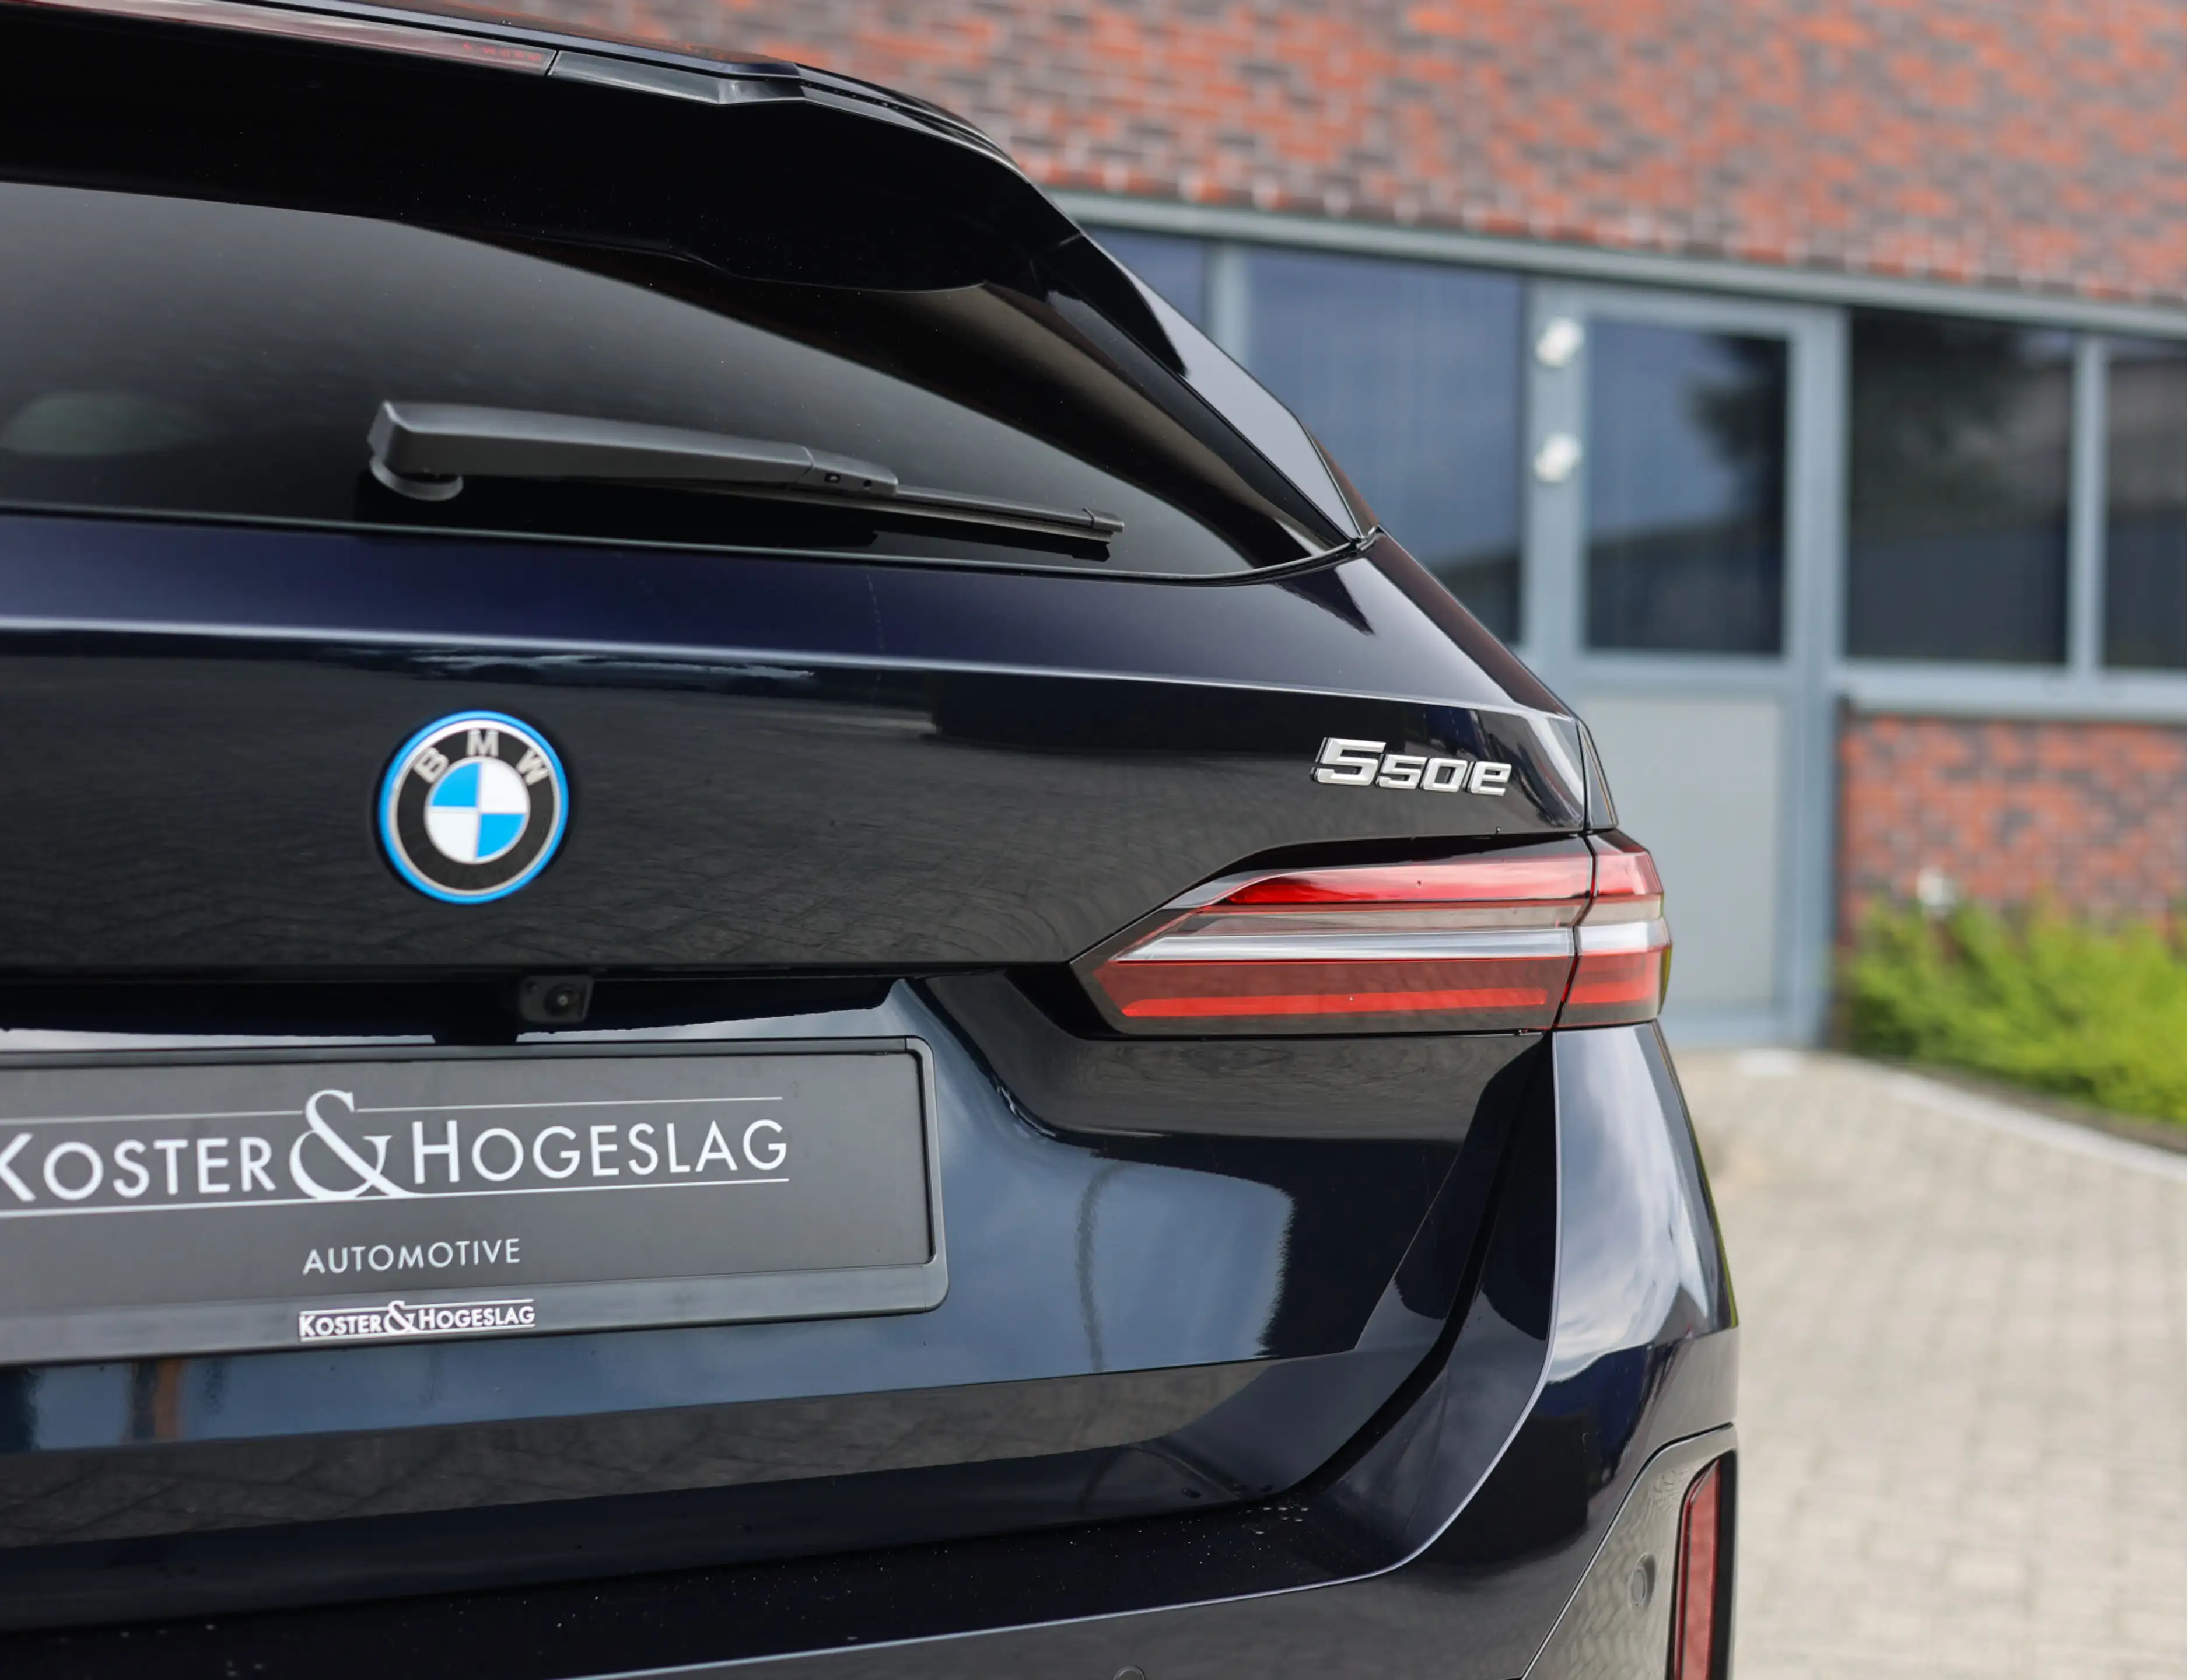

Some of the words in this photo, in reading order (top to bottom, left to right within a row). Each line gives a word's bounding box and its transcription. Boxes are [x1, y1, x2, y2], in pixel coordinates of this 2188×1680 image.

[412, 728, 549, 786] BMW
[1310, 737, 1512, 797] 550e
[302, 1238, 521, 1275] AUTOMOTIVE
